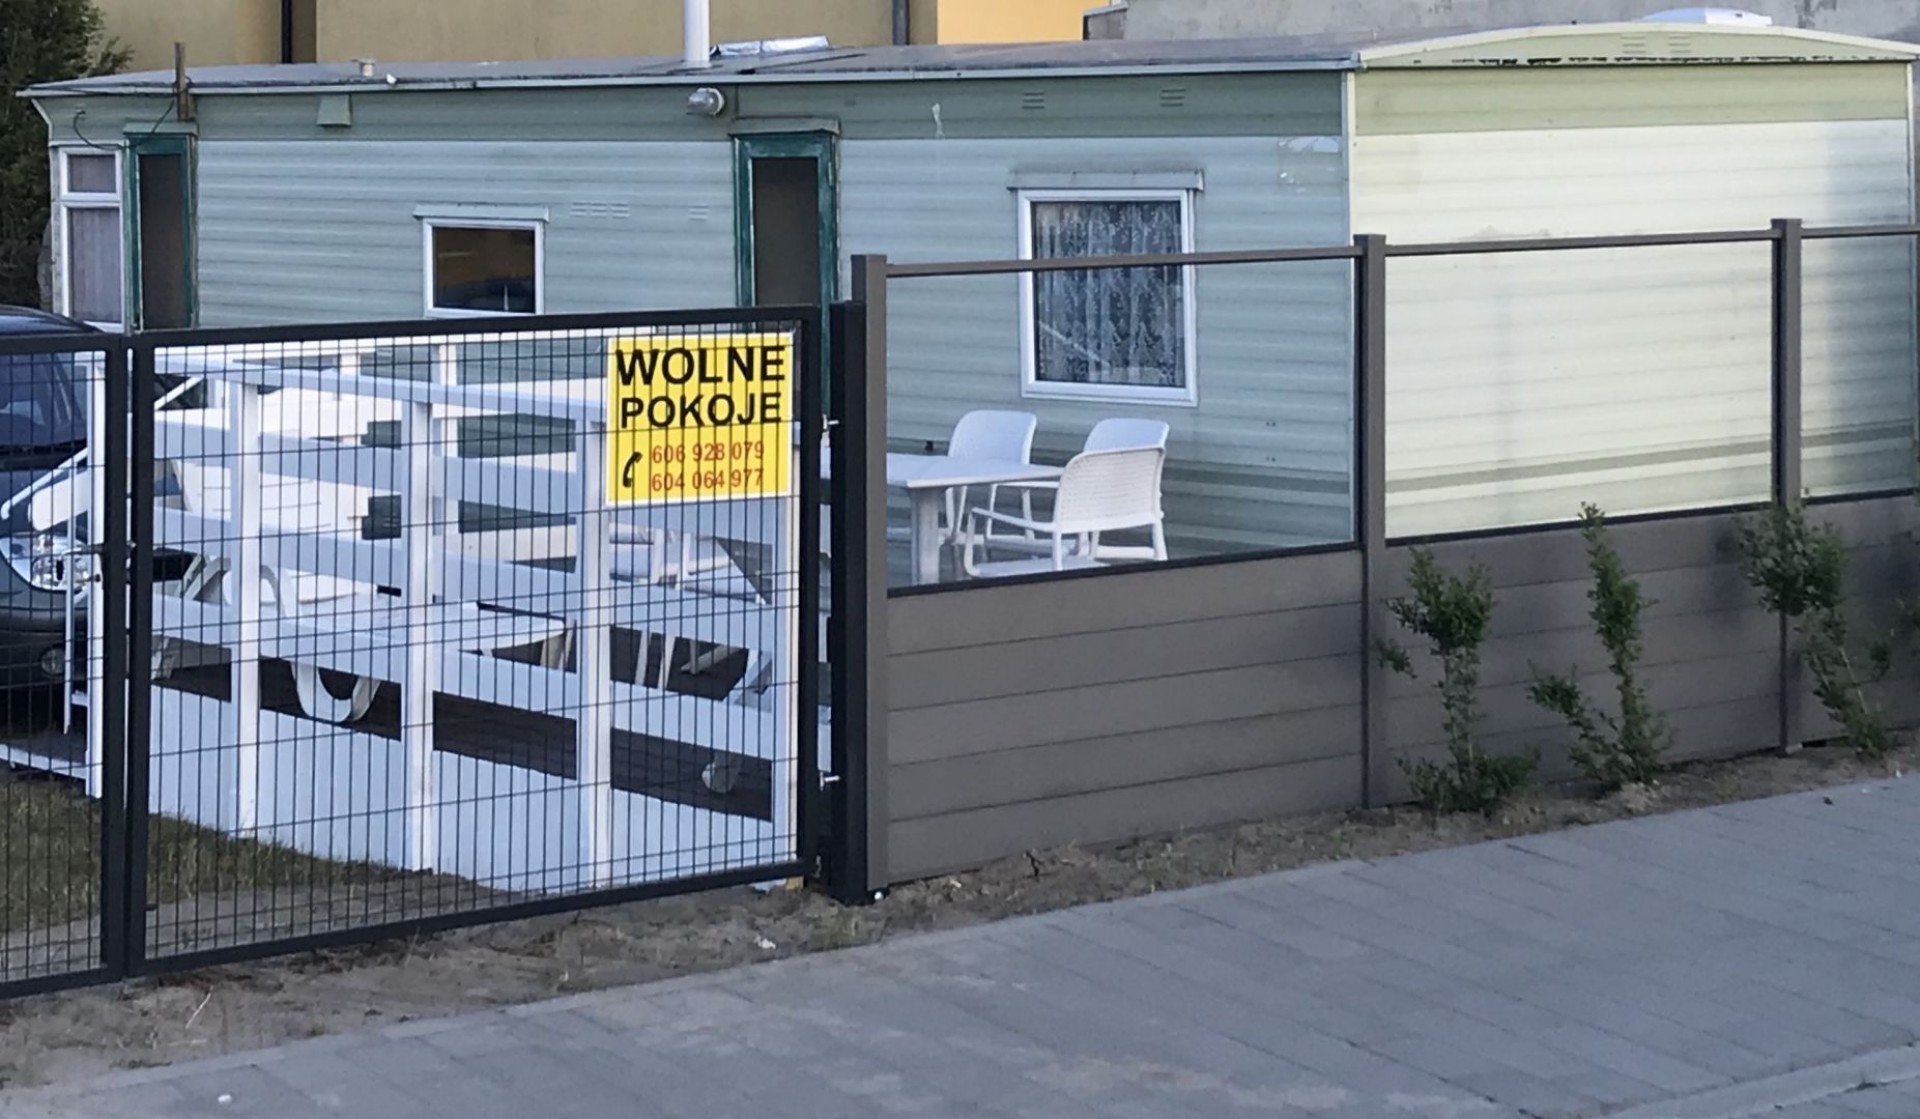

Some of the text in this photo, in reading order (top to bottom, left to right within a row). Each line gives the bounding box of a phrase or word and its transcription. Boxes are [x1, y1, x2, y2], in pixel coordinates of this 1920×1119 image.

[616, 345, 785, 386] WOLNE
[621, 392, 782, 428] POKOJE
[652, 445, 685, 464] 606
[692, 443, 725, 461] 928
[651, 468, 764, 492] 604 064 977
